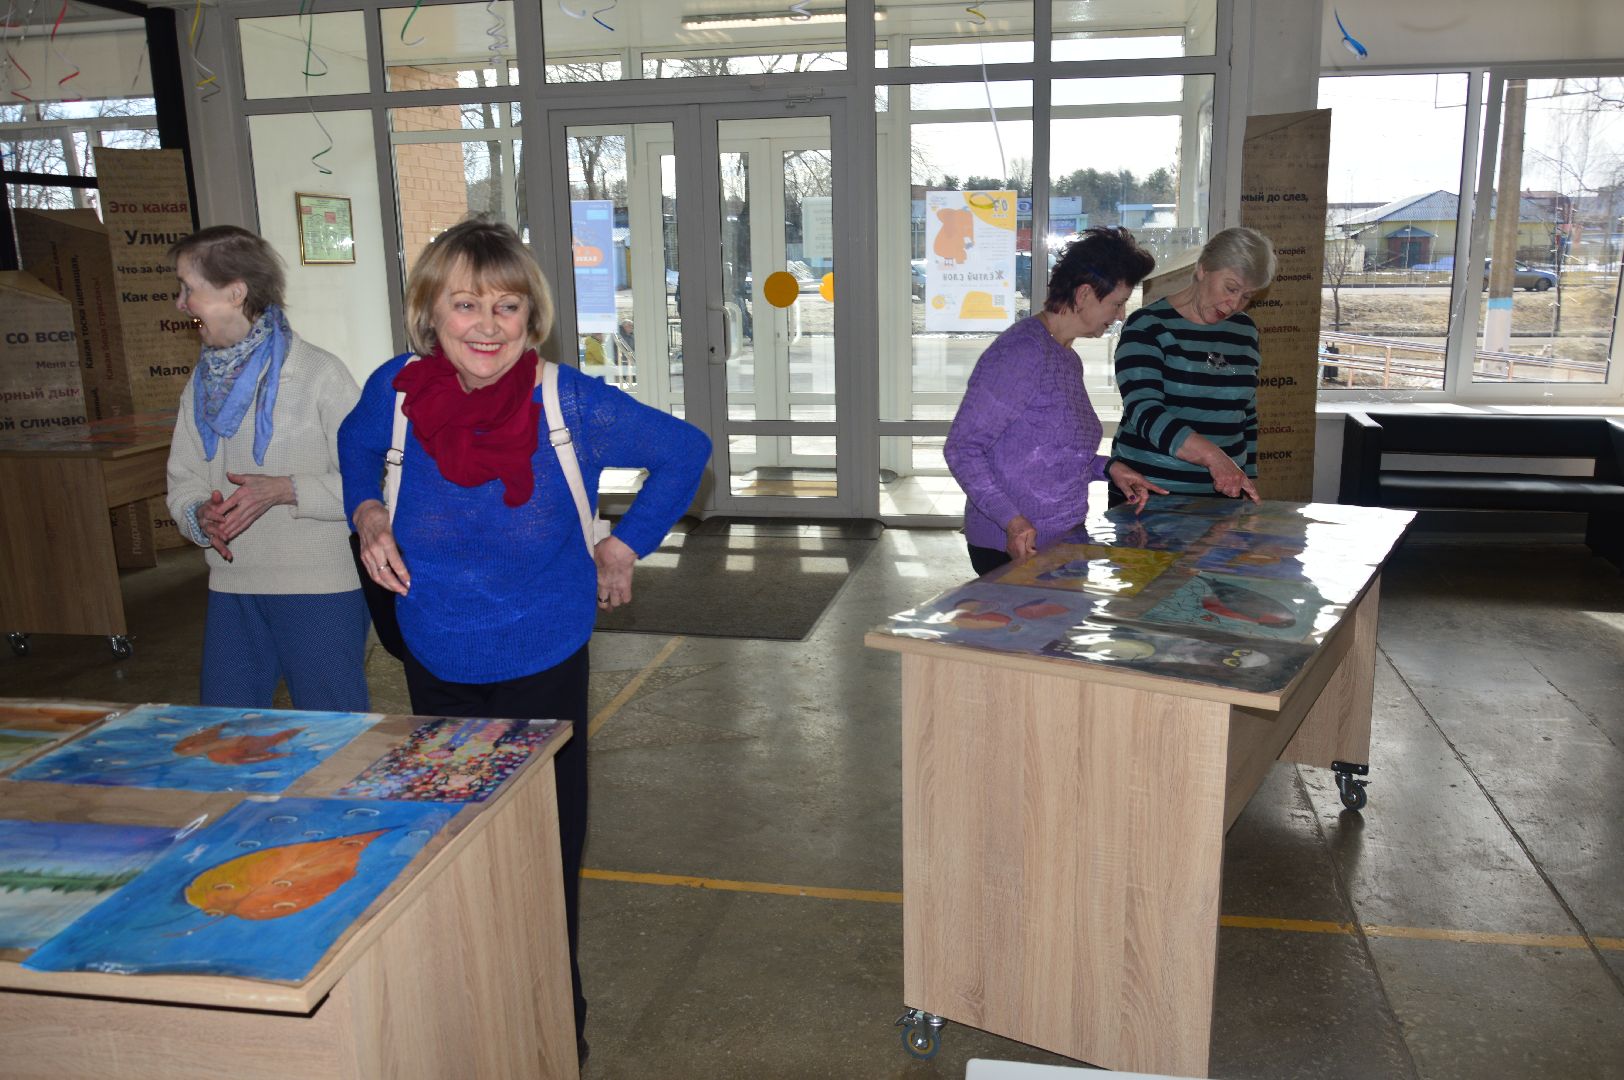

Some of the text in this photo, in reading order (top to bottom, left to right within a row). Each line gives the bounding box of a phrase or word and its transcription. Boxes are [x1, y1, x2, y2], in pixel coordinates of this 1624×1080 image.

[1267, 193, 1280, 203] до
[1283, 193, 1309, 203] слез,
[109, 201, 188, 214] Это какая
[1278, 246, 1306, 256] скорей
[117, 266, 138, 274] Что
[156, 264, 176, 275] фа
[1276, 272, 1314, 283] фонарей.
[122, 292, 149, 302] Как
[152, 292, 168, 301] ее
[79, 309, 89, 336] тоска
[160, 319, 198, 333] Крив
[5, 332, 29, 344] со
[36, 360, 67, 369] Меня
[149, 365, 190, 377] Мало
[1257, 376, 1297, 389] мера.
[47, 387, 80, 400] дым
[20, 415, 86, 429] сличаю
[1258, 426, 1295, 435] голоса.
[1259, 451, 1292, 461] висок
[154, 519, 178, 528] Это
